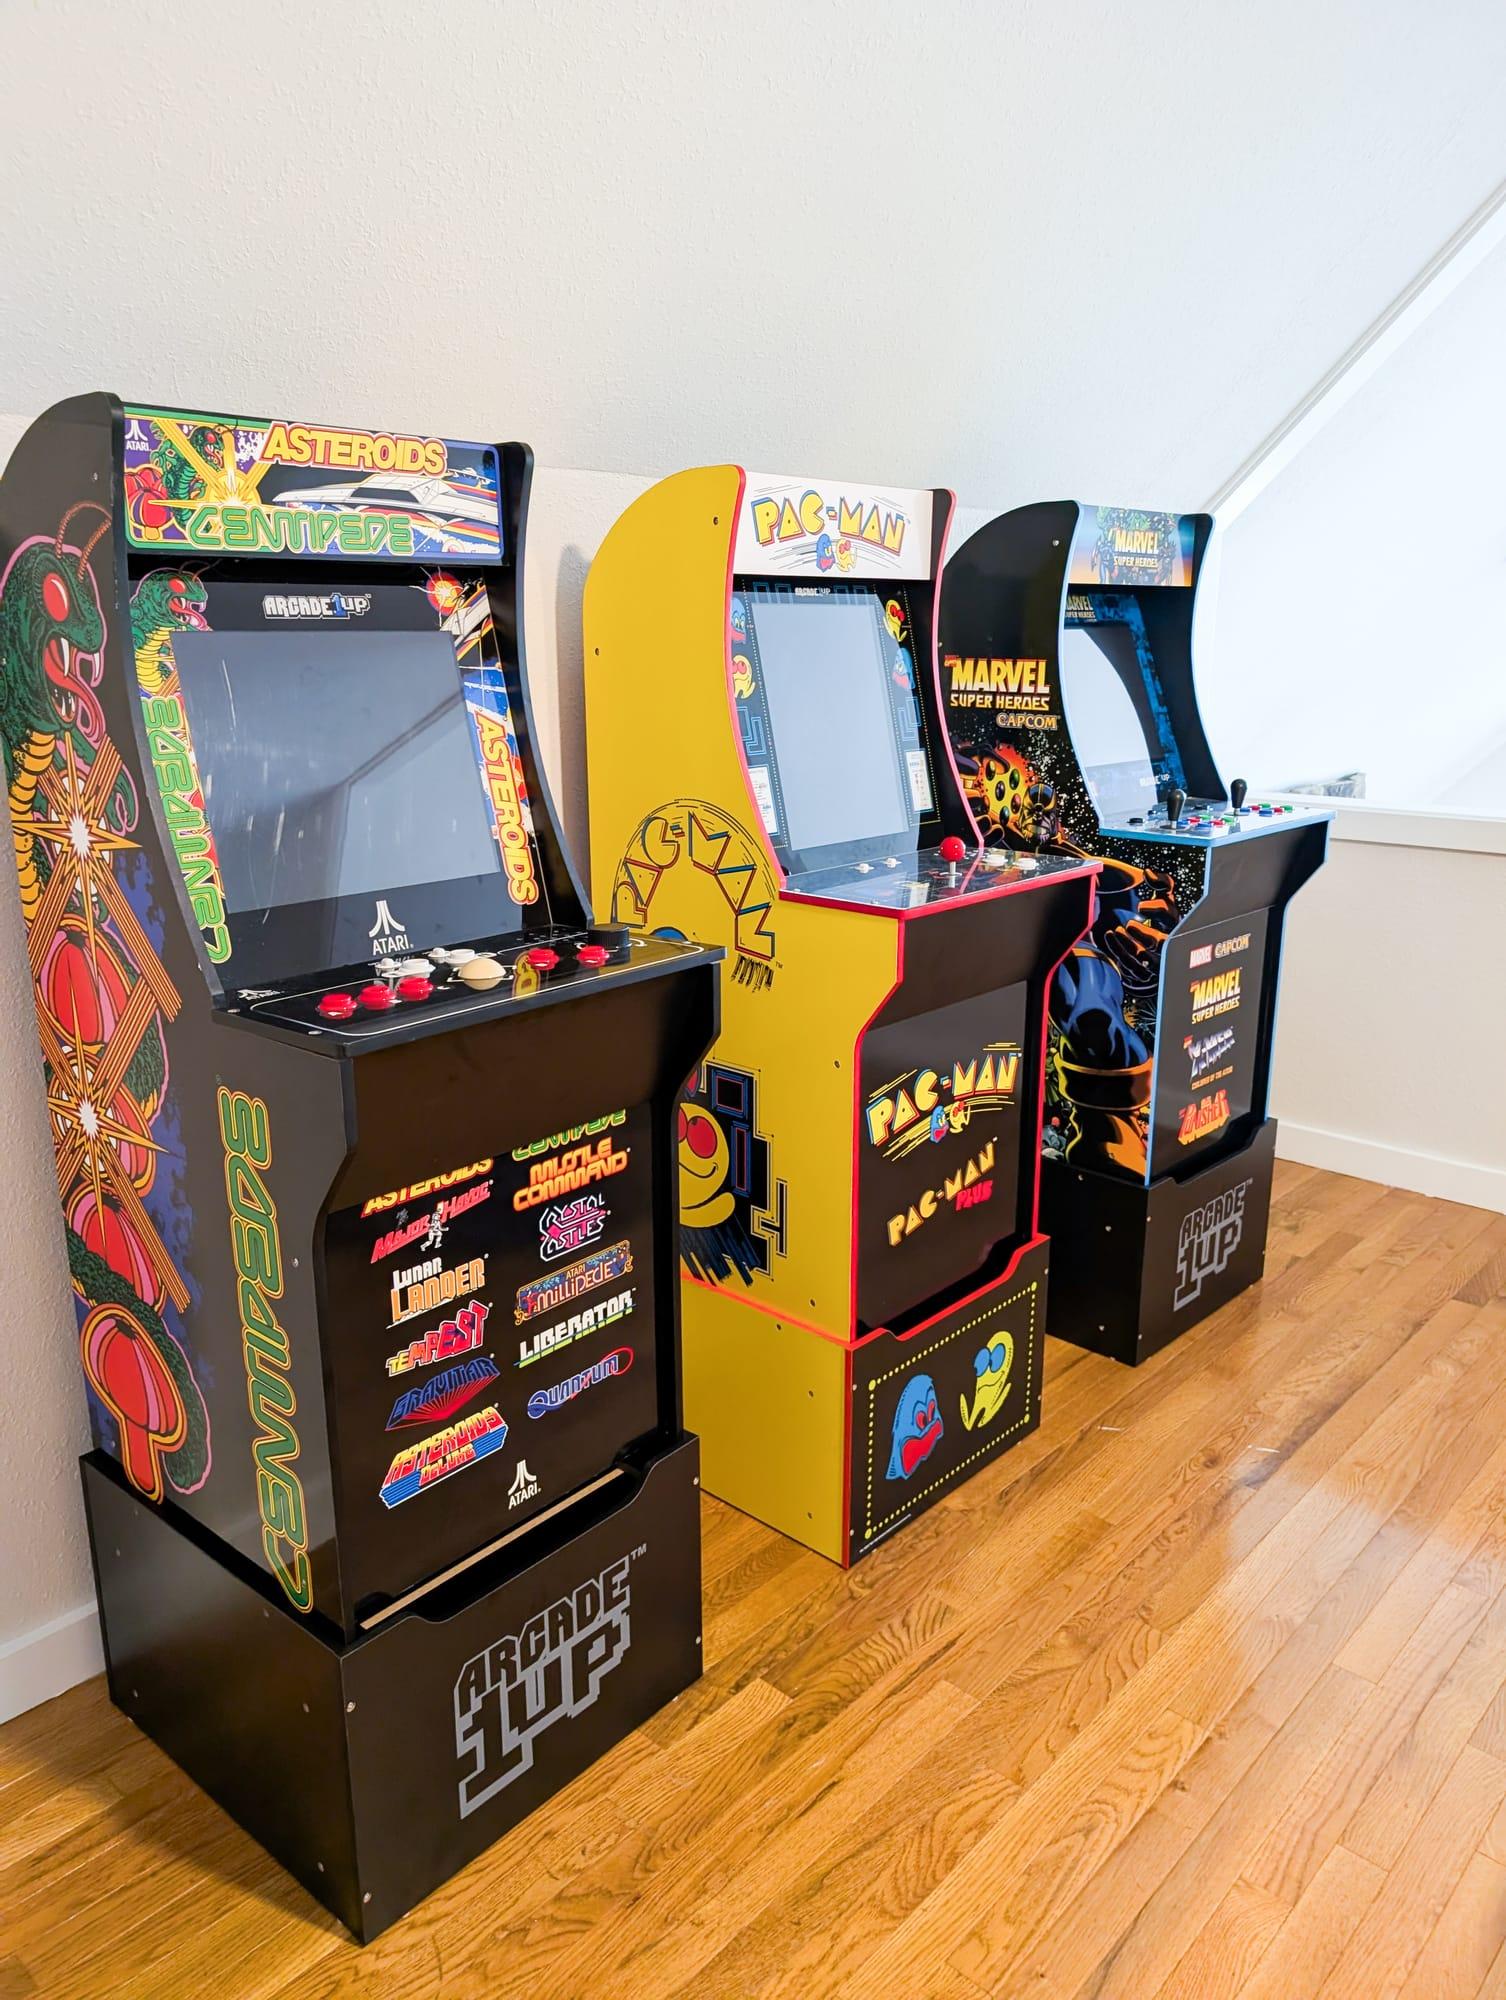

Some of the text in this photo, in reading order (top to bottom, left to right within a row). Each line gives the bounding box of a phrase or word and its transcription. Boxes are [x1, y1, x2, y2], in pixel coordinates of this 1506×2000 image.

[126, 440, 150, 451] ATARI
[258, 421, 448, 476] ASTEROIDS
[186, 504, 416, 557] CENTIPEDE
[750, 489, 907, 556] PAC-MAN
[1114, 528, 1159, 555] MARVEL
[950, 694, 1050, 711] SUPER HEROES
[951, 657, 1051, 694] MARVEL
[996, 711, 1059, 731] CAPCOM
[139, 694, 233, 964] CENTIPEDE
[472, 708, 539, 906] ASTEROIDS
[610, 810, 776, 962] PAC-MAN
[372, 933, 410, 956] ATARI
[1215, 933, 1251, 959] CAPCOM
[1191, 967, 1241, 1012] MARVEL
[1191, 1004, 1214, 1025] SUPER
[866, 1053, 1018, 1147] PAC-MAN
[513, 1149, 628, 1212] COMMAND
[530, 1137, 612, 1185] MISSILE
[370, 1181, 491, 1264] MAJOR HAVOC
[887, 1142, 995, 1247] PAC-MAN
[955, 1180, 994, 1211] PLUS
[1180, 1182, 1246, 1252] ARCADE
[566, 1263, 586, 1279] ATARI
[1173, 1215, 1243, 1312] 1UP
[217, 1085, 314, 1614] CENTIPEDE
[386, 1300, 489, 1377] TEMPEST
[519, 1290, 633, 1363] LIBERATOR
[527, 1354, 619, 1419] QUANTUM
[382, 1406, 505, 1489] ASTEROIDS
[508, 1484, 538, 1510] ATARI
[454, 1555, 630, 1724] ARCADE
[456, 1612, 631, 1820] 1UP
